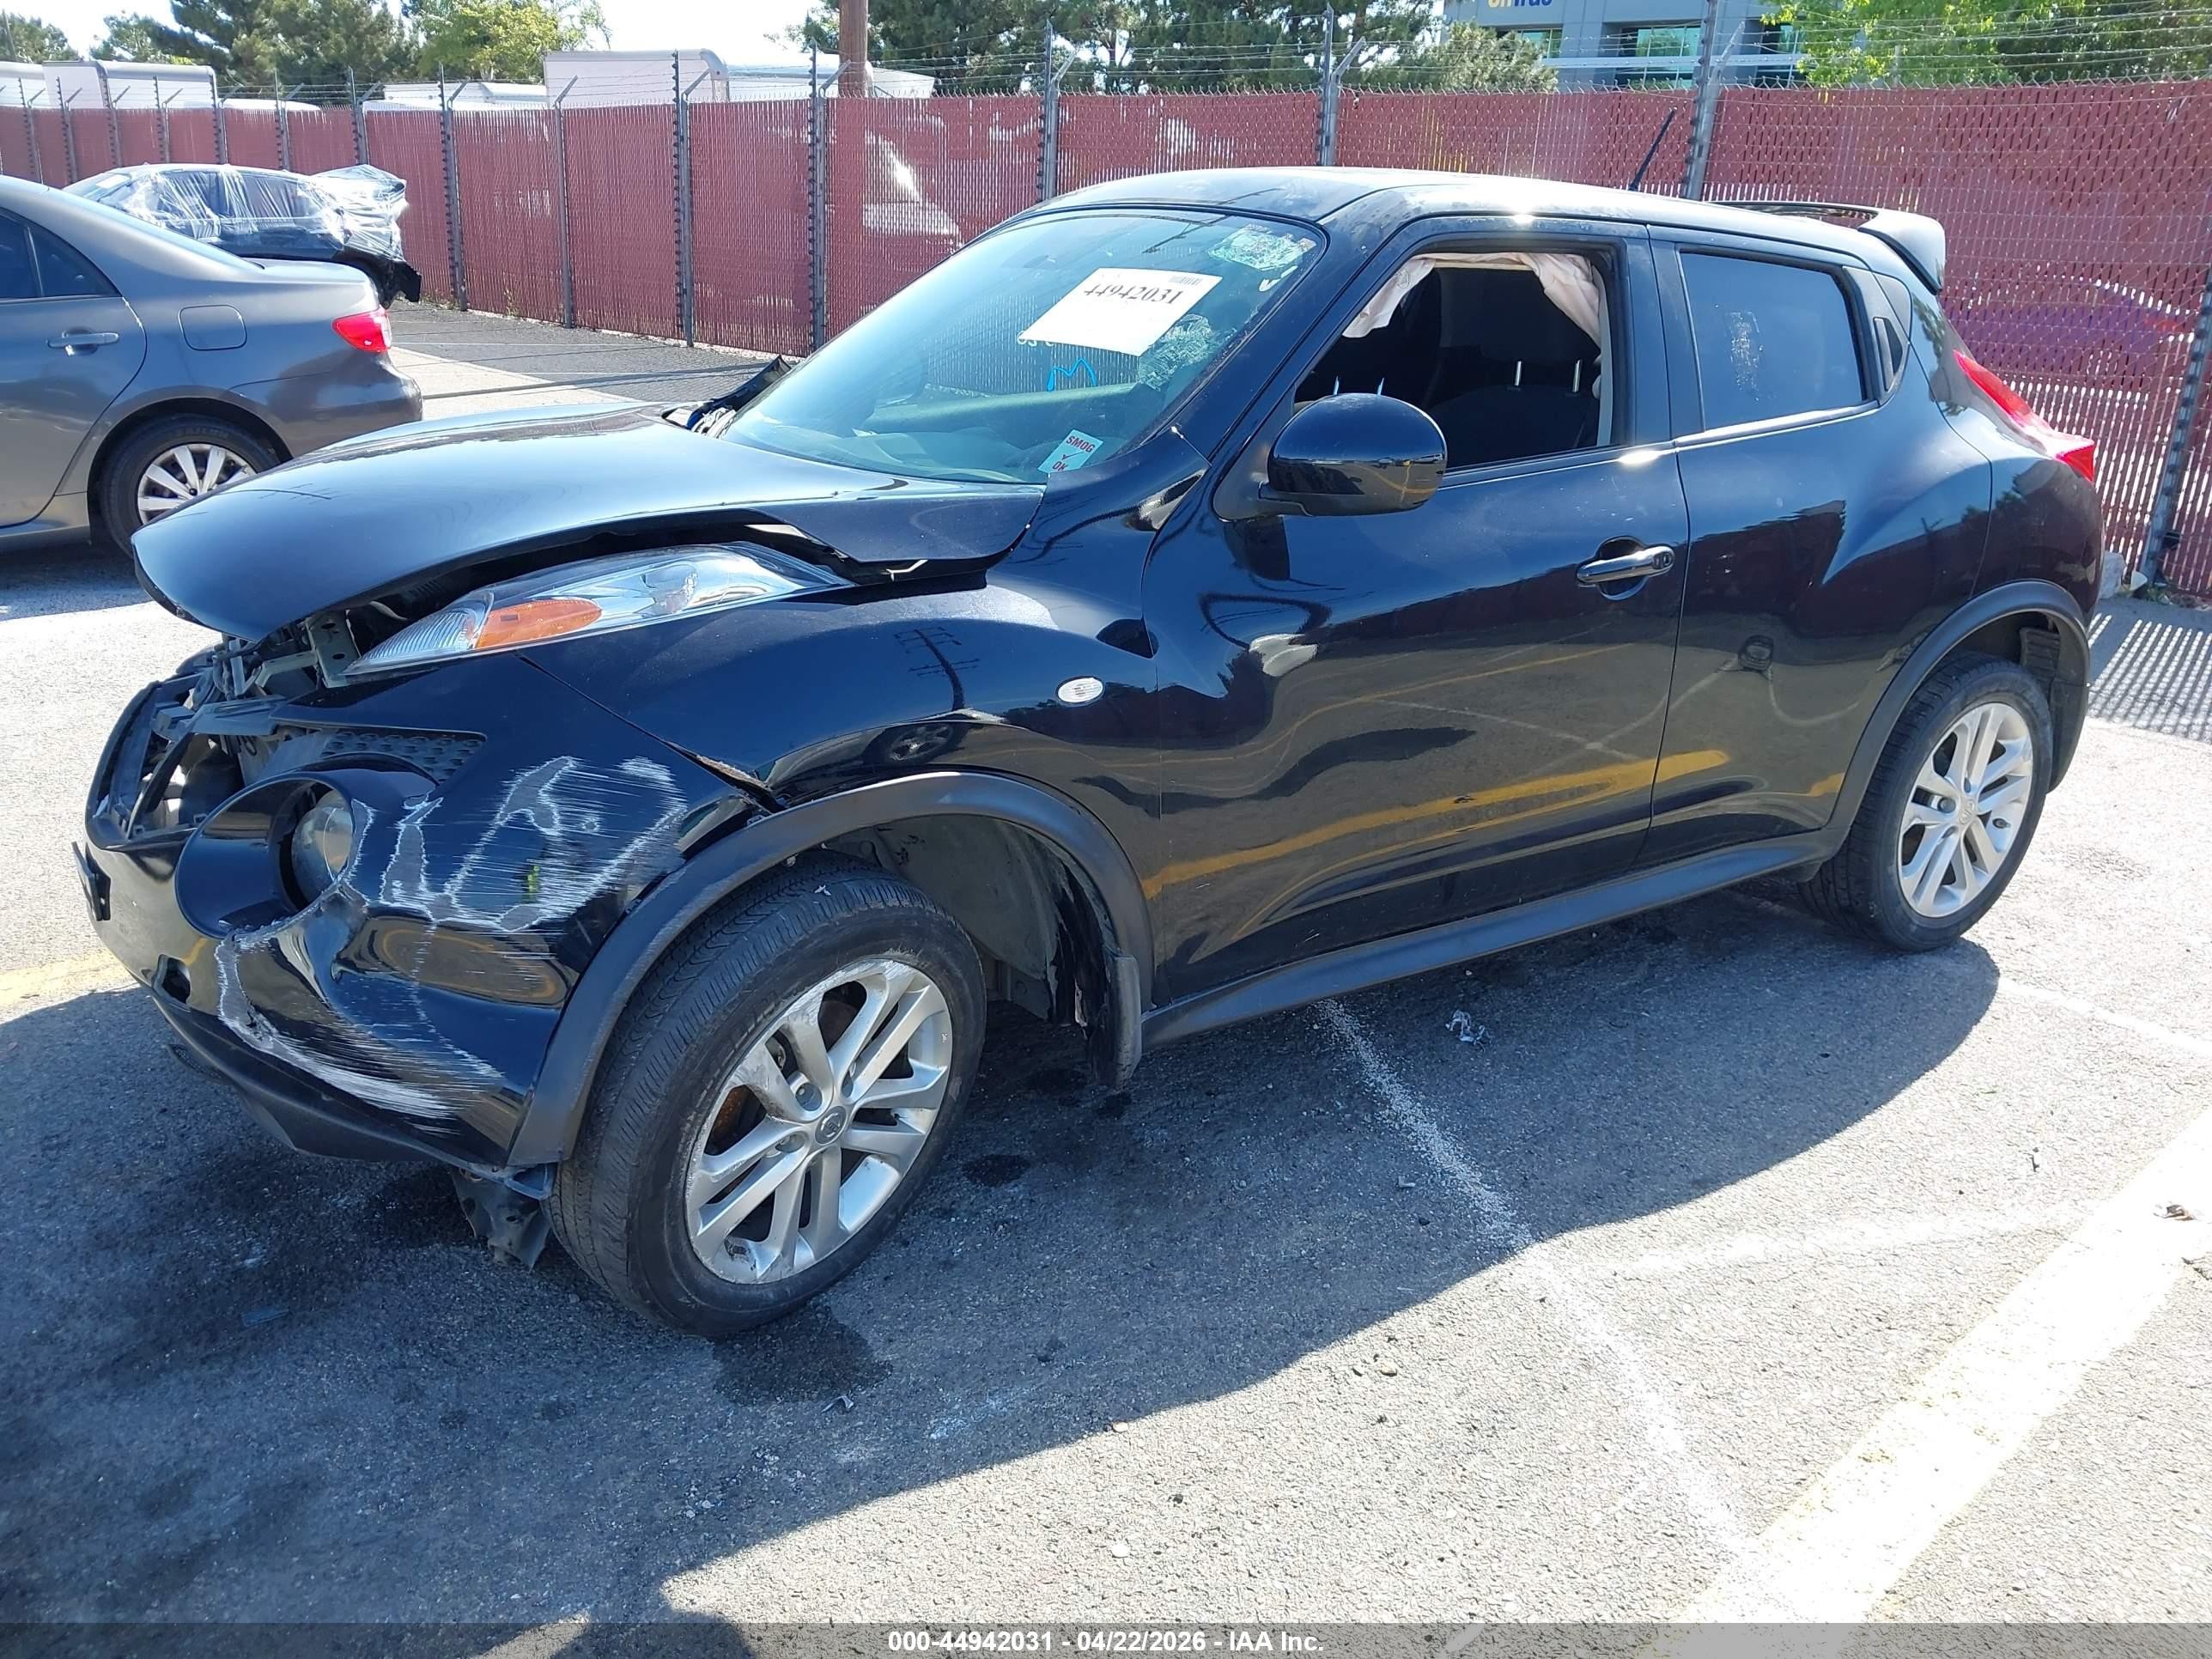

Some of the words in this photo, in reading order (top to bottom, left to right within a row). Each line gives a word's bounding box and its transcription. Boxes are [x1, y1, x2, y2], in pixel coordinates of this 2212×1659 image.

[1084, 284, 1183, 304] 44942031
[1066, 435, 1096, 453] SMOG
[1052, 461, 1068, 471] OK
